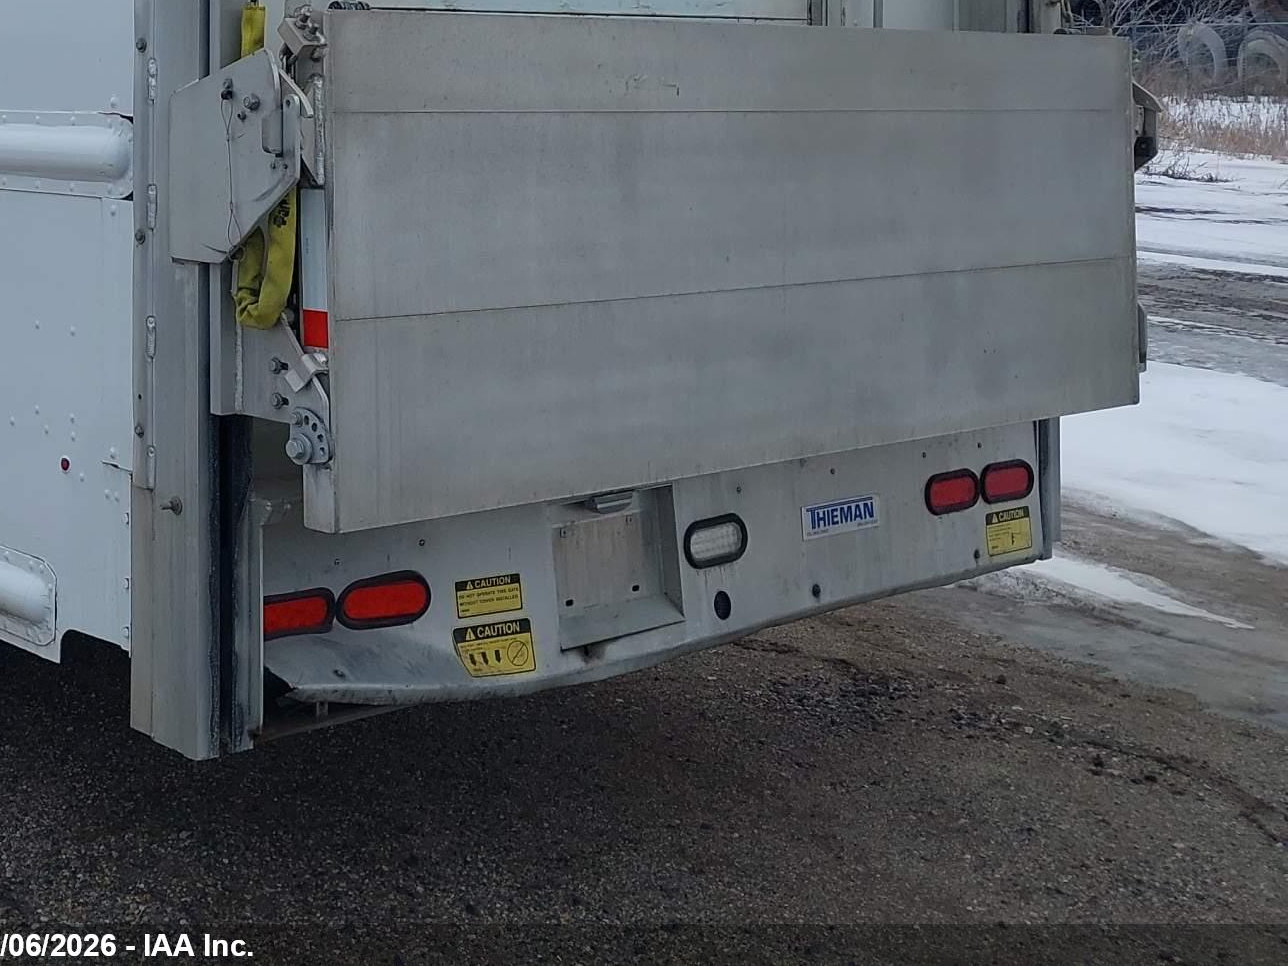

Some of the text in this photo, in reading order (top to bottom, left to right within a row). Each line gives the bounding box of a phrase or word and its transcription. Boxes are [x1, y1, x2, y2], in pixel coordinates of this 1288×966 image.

[806, 497, 874, 530] THIEMAN
[474, 575, 511, 589] CAUTION
[476, 620, 521, 638] CAUTION
